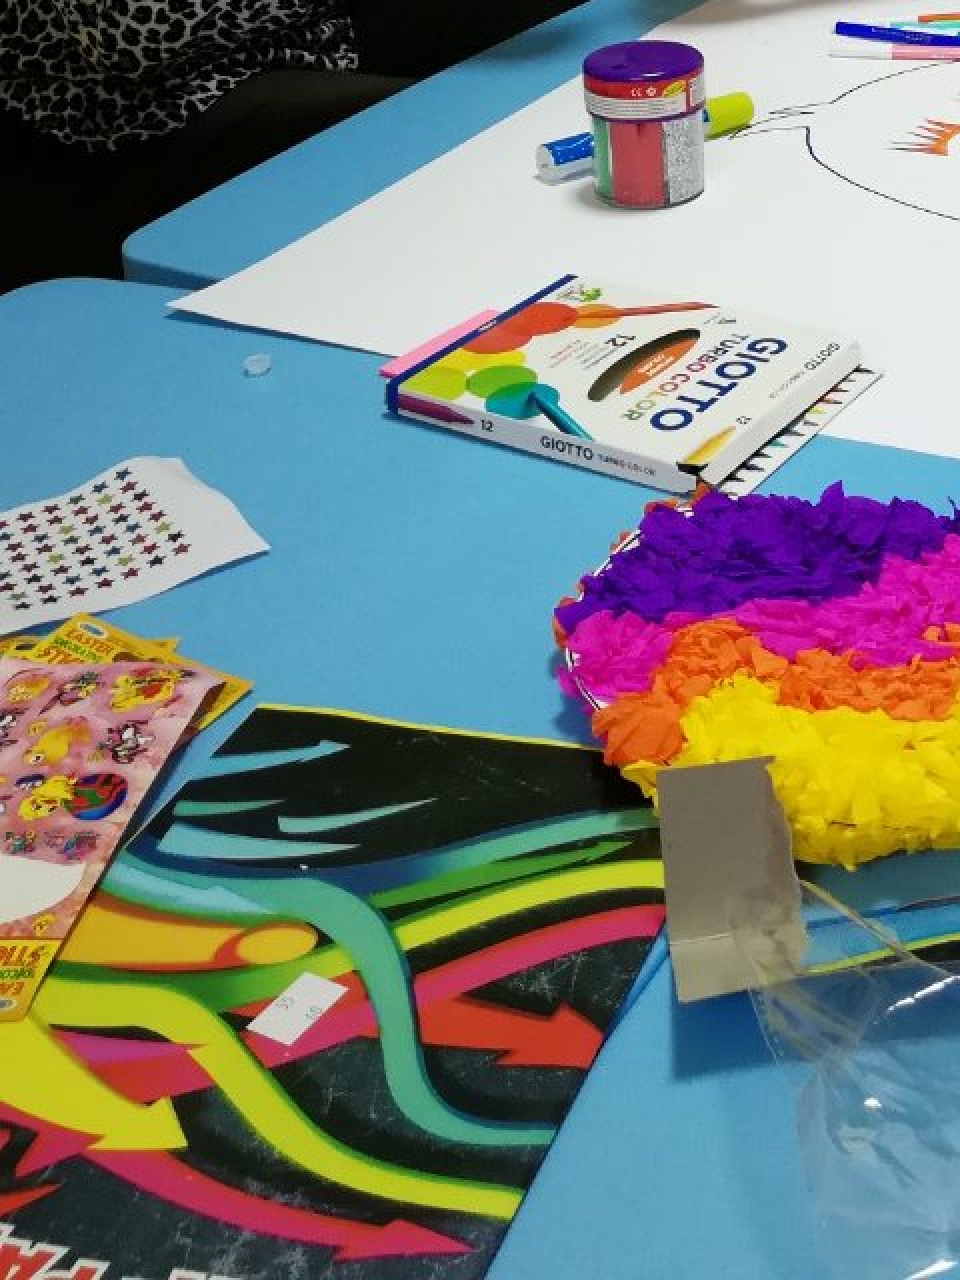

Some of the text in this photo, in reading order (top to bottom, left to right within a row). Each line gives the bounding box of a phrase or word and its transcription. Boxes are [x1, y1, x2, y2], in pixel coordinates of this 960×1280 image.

[685, 333, 750, 373] TURBO
[803, 341, 841, 371] GIOTTO
[621, 372, 691, 422] COLOR
[650, 337, 787, 431] GIOTTO
[480, 419, 493, 433] 12
[540, 435, 595, 461] GIOTTO
